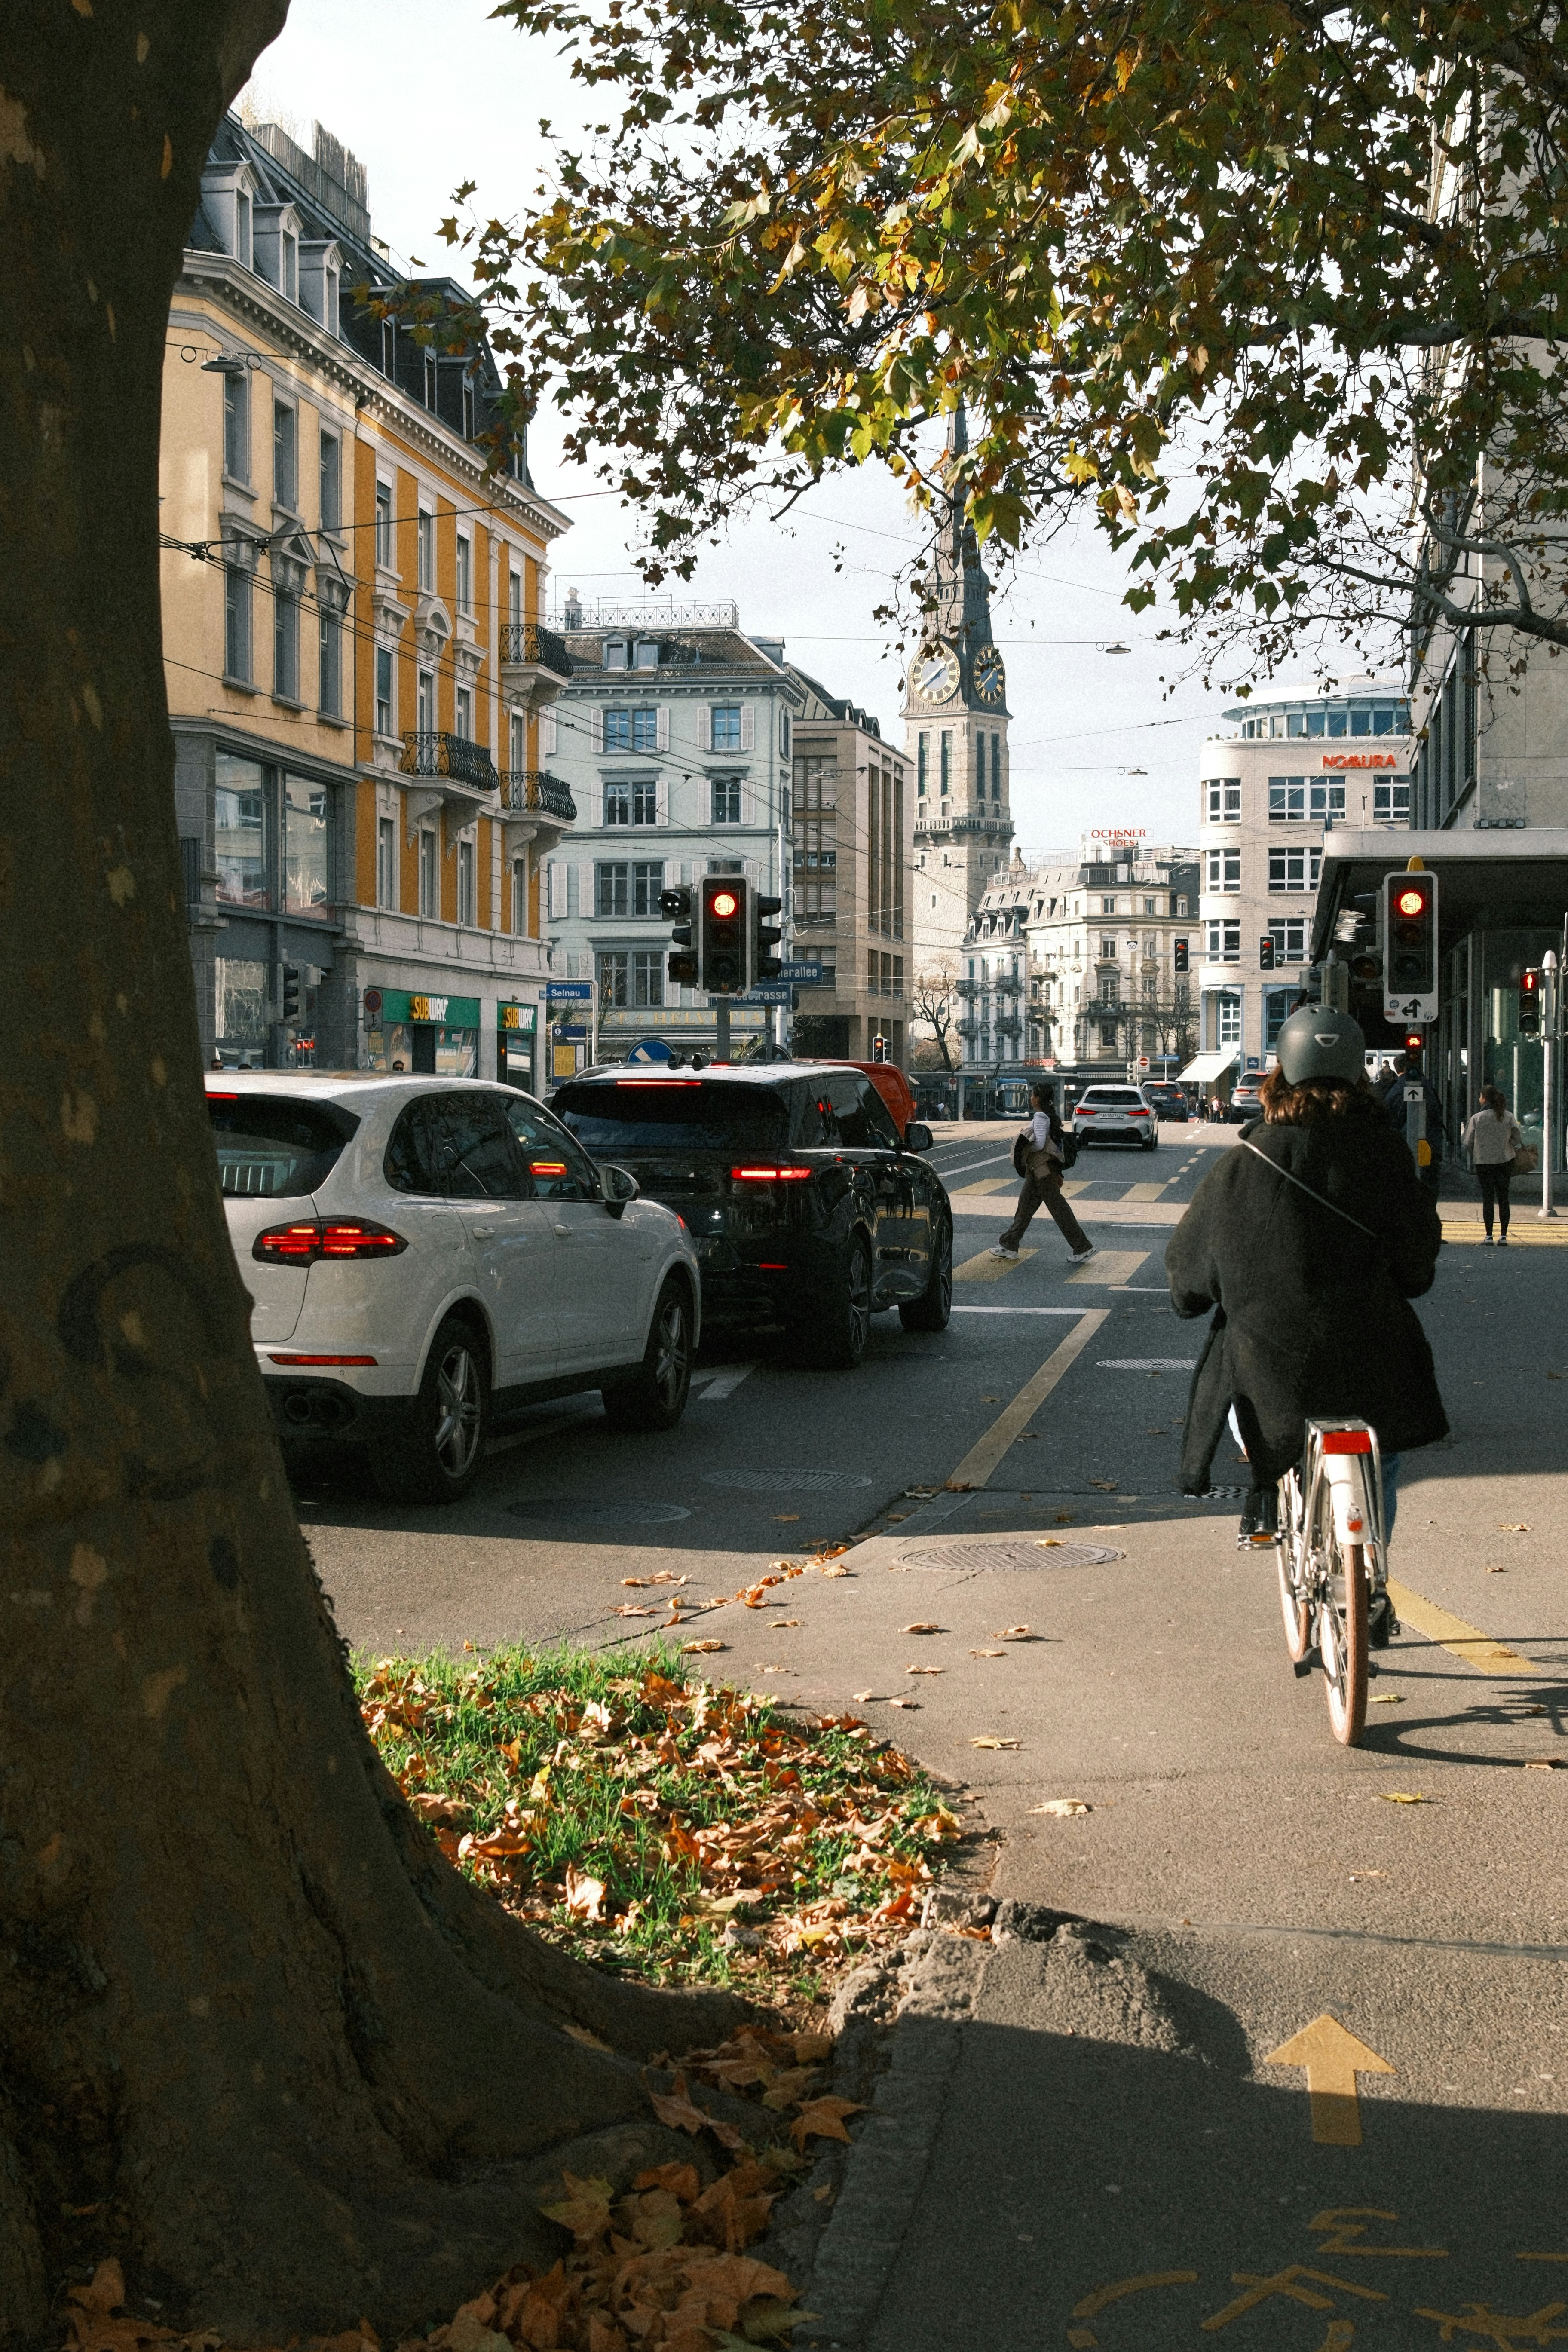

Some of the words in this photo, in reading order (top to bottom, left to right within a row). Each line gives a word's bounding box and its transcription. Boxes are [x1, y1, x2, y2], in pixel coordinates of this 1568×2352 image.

[1323, 754, 1396, 769] NOMURA
[1091, 829, 1146, 838] OCHSNER
[411, 996, 448, 1022] SUBWAY
[504, 1006, 534, 1029] SUBWAY
